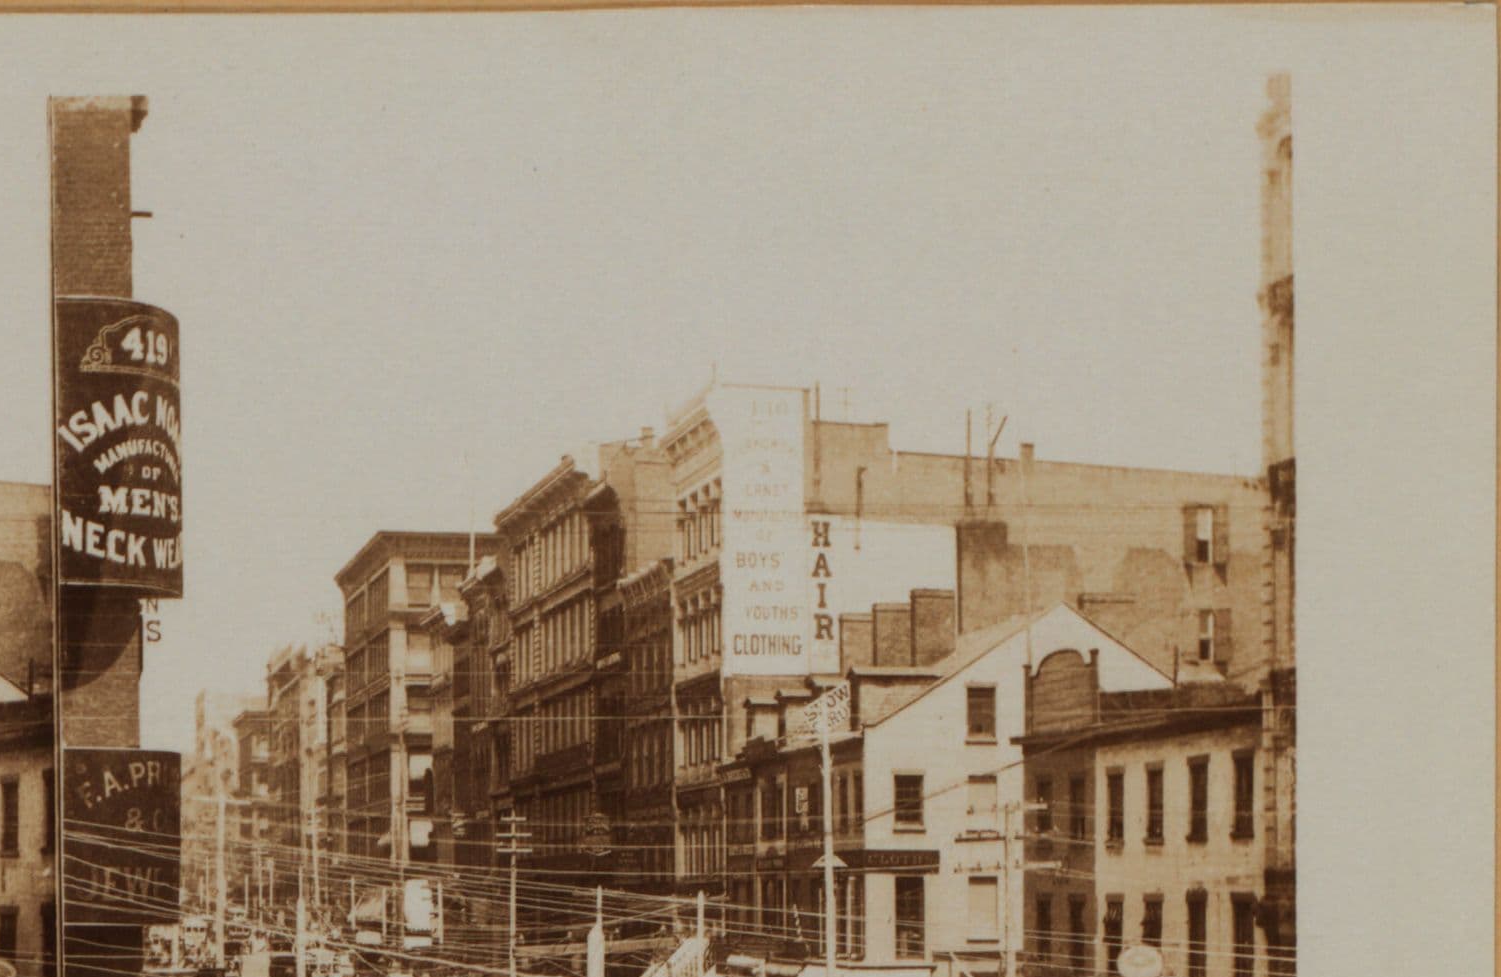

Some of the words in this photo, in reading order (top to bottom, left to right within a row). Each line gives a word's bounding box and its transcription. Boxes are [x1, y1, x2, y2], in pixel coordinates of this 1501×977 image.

[120, 326, 168, 366] 419
[57, 390, 150, 452] ISAAC
[142, 465, 162, 481] OF
[98, 486, 179, 524] MEN'S
[62, 509, 148, 568] NECK
[733, 634, 802, 656] CLOTHING
